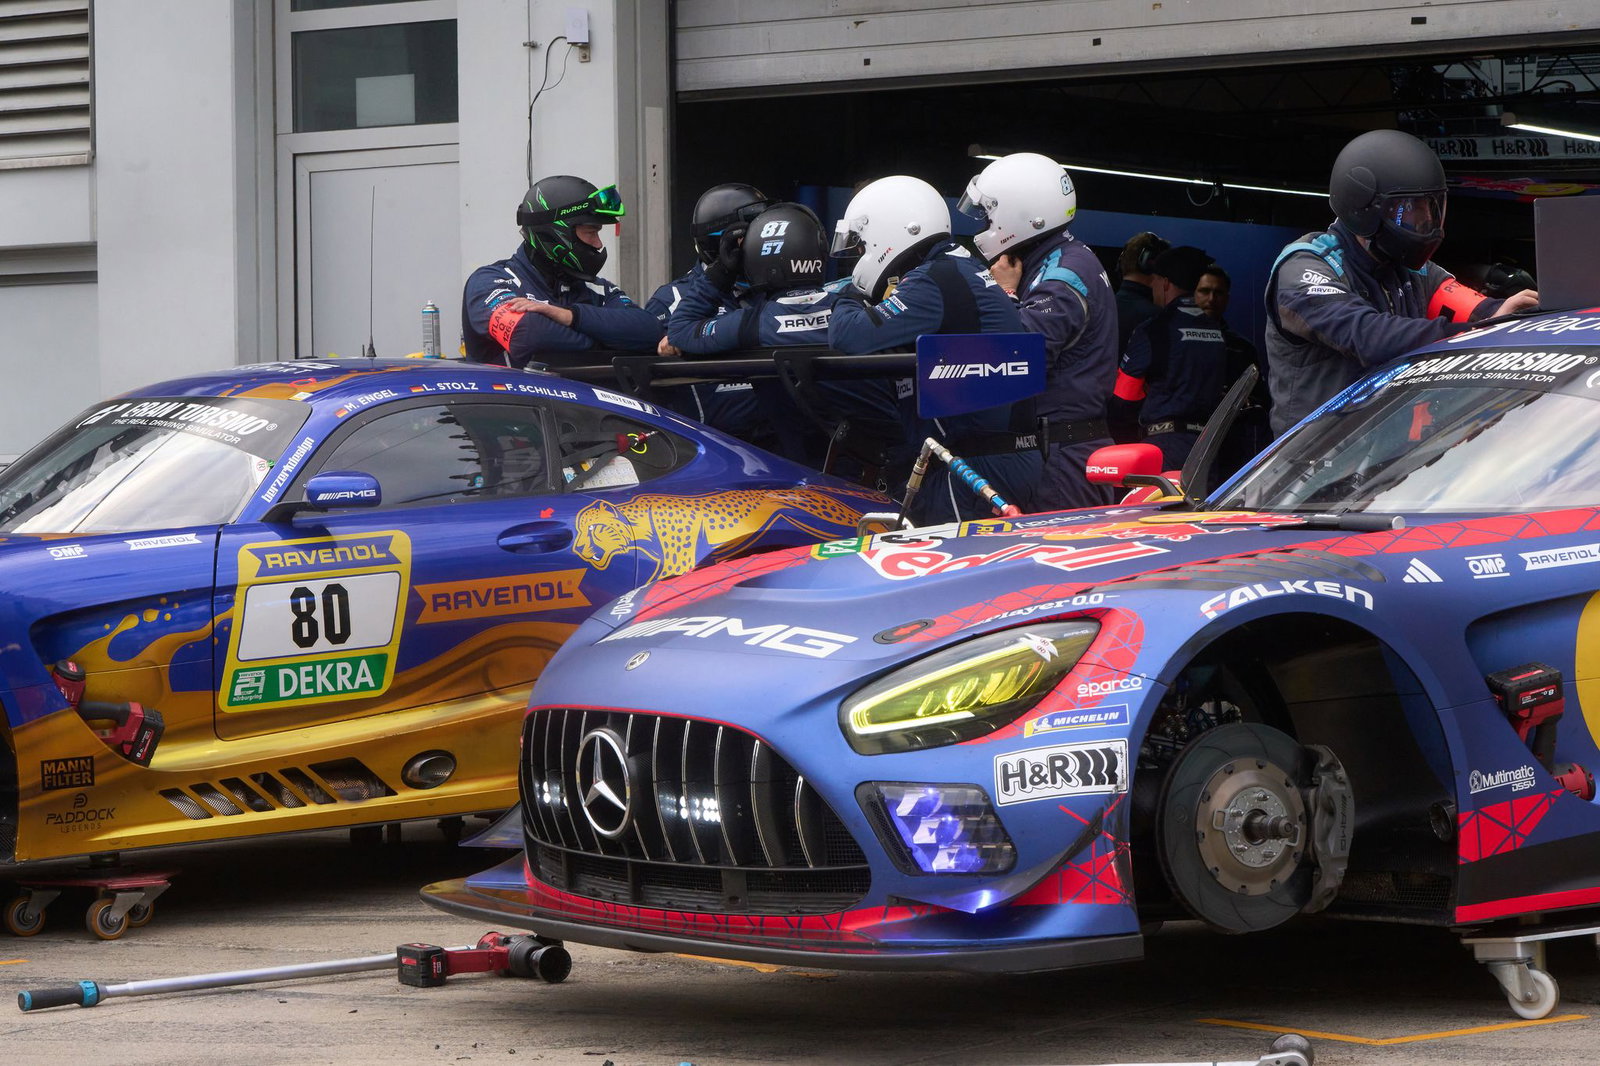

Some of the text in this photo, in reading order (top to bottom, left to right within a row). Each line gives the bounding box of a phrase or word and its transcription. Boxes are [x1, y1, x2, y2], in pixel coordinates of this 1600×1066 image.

[1492, 139, 1526, 155] H&R
[1564, 139, 1597, 154] H&R
[760, 220, 791, 239] 81
[760, 240, 785, 256] 57
[1185, 330, 1221, 340] RAVENOL
[961, 361, 1029, 378] AMG
[1398, 356, 1466, 380] GRAN
[423, 382, 479, 392] L. STOLZ
[1403, 376, 1432, 385] REAL
[1434, 372, 1483, 382] DRIVING
[1485, 372, 1556, 383] SIMULATOR
[344, 388, 399, 413] M. ENGEL
[505, 383, 578, 401] F. SCHILLER
[124, 401, 181, 420] GRAN
[111, 418, 242, 445] THE REAL DRIVING SIMULATOR
[337, 488, 376, 500] AMG
[134, 534, 195, 549] RAVENOL
[49, 546, 85, 558] OMP
[264, 544, 387, 569] RAVENOL
[1531, 549, 1597, 566] RAVENOL
[1468, 557, 1506, 575] OMP
[431, 581, 575, 612] RAVENOL
[1199, 579, 1374, 620] FALKEN
[289, 583, 352, 649] 80
[645, 616, 859, 659] AMG
[278, 659, 376, 698] DEKRA
[1077, 676, 1143, 697] sparco
[1053, 711, 1120, 726] MICHELIN
[43, 759, 91, 775] MANN
[1001, 753, 1071, 793] H&R
[1482, 764, 1535, 788] Multimatic
[44, 772, 92, 788] FILTER
[45, 808, 116, 825] PADDOCK
